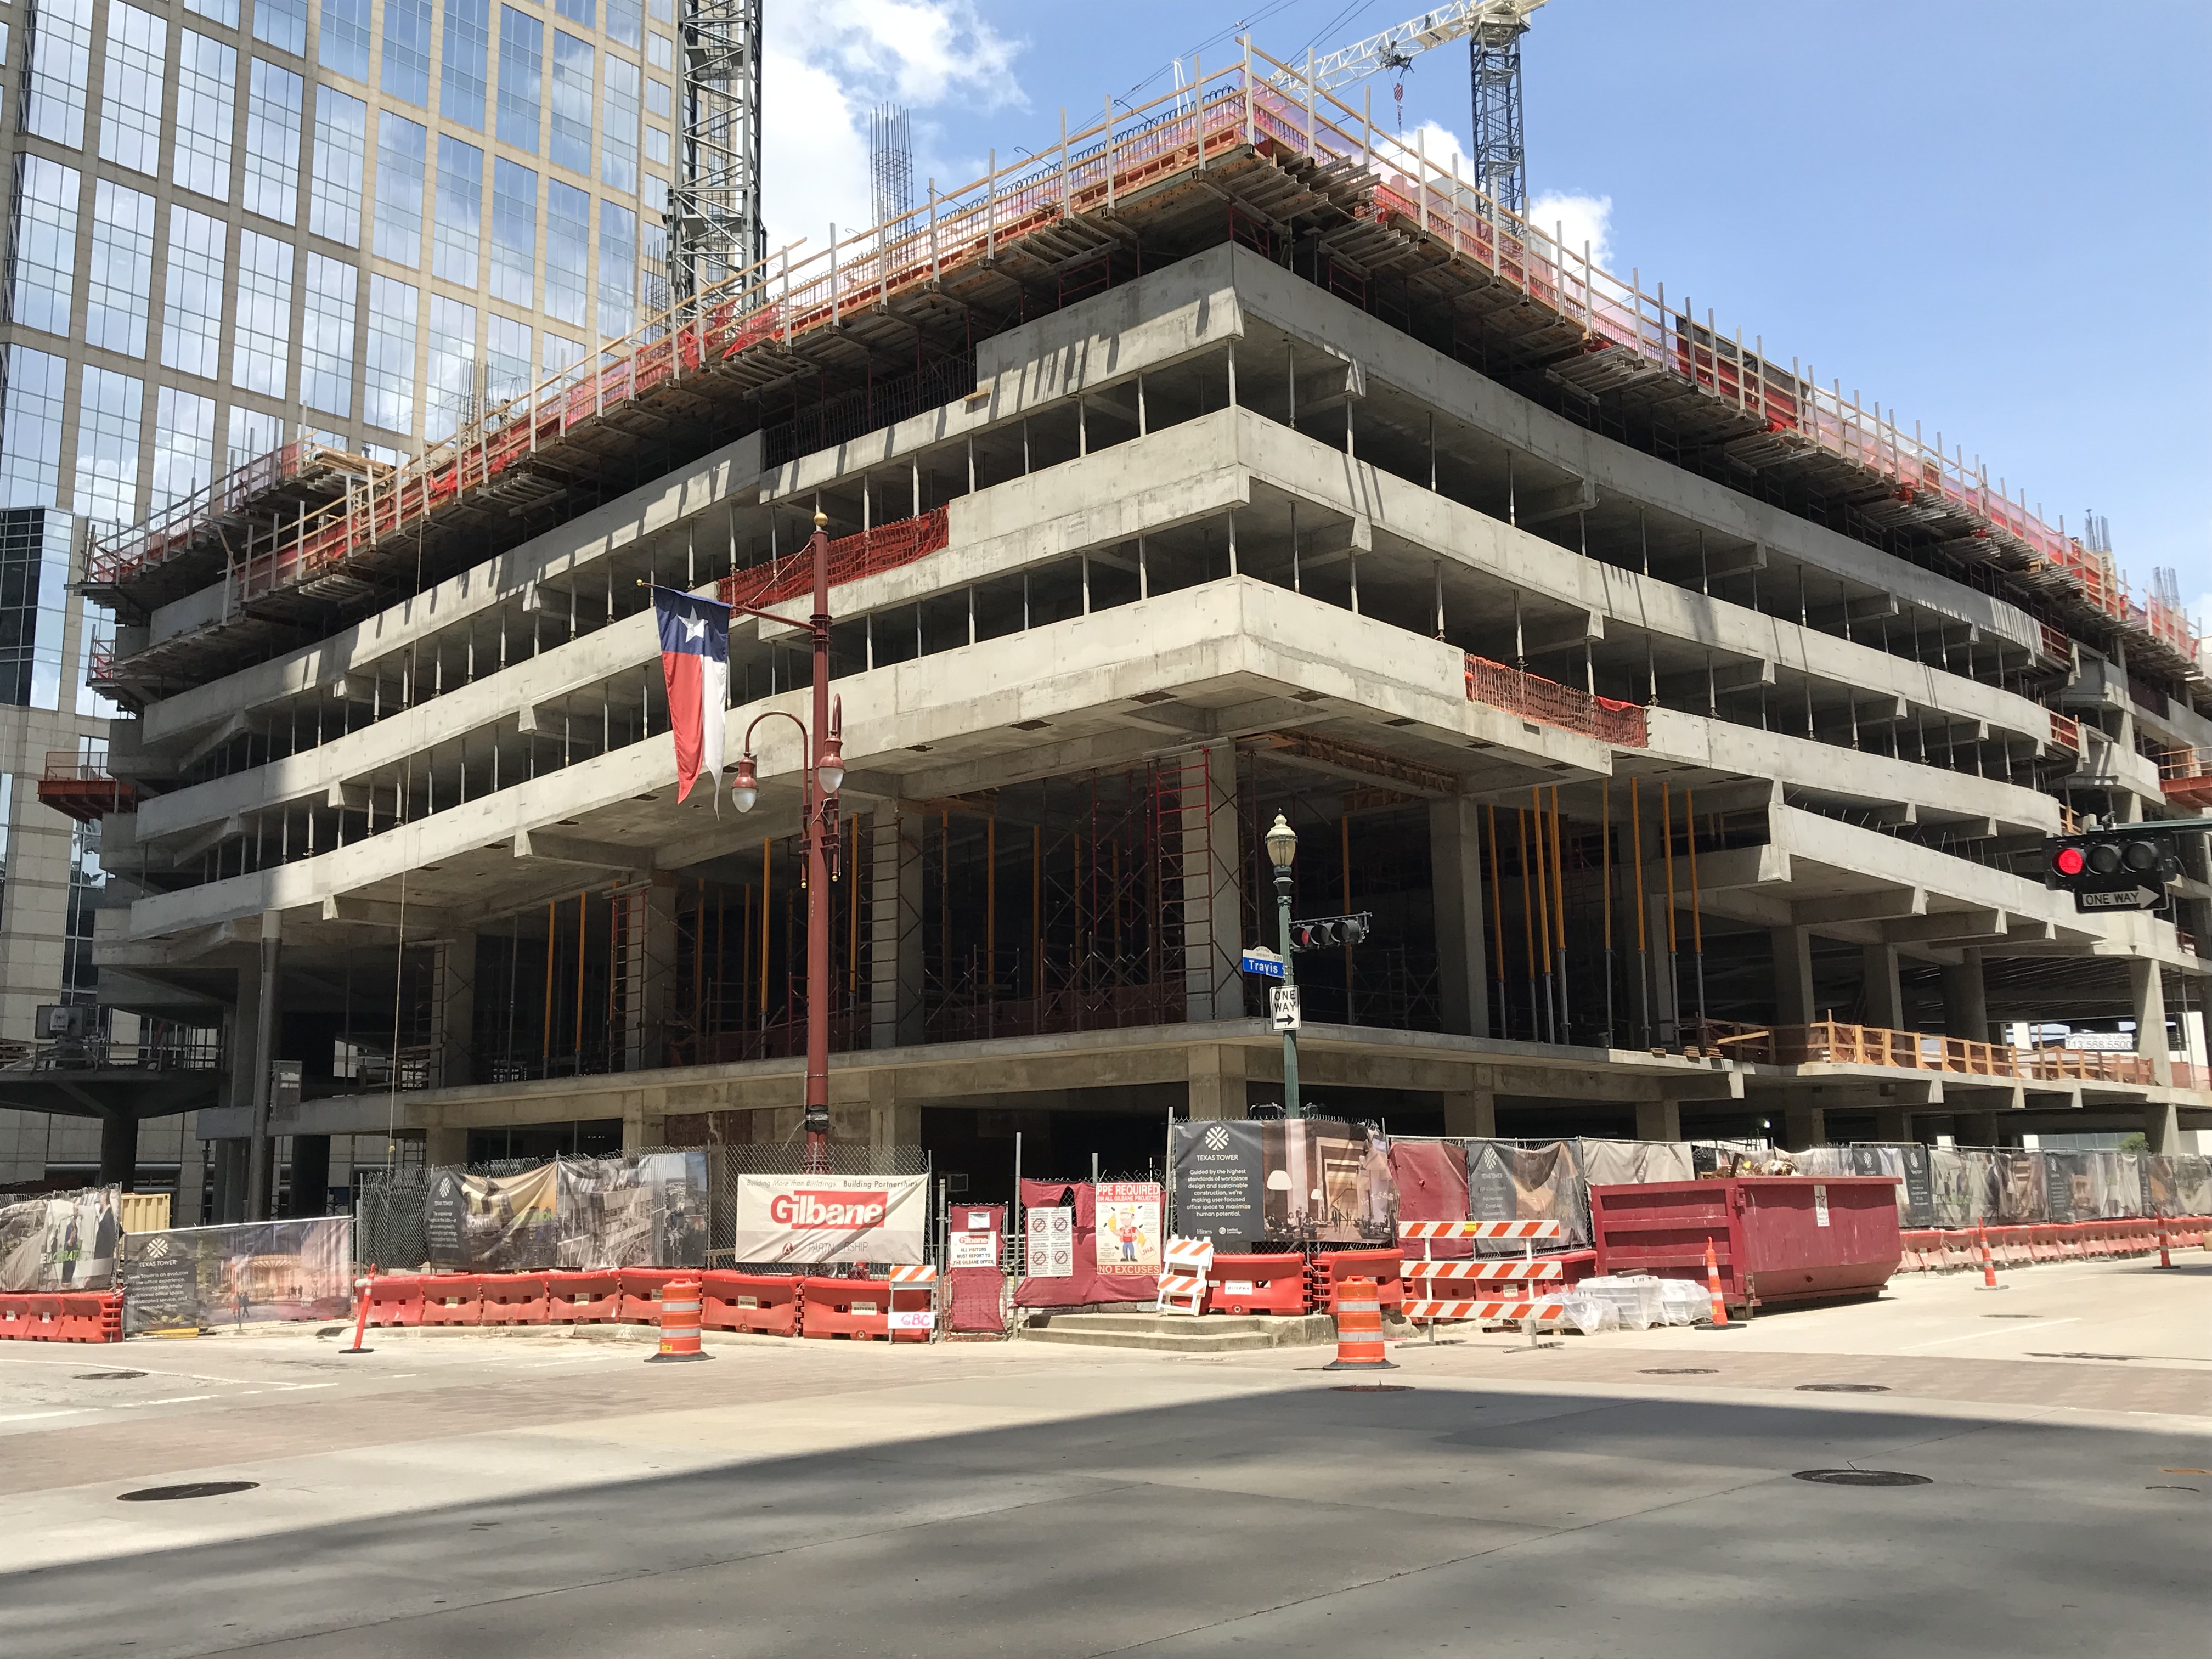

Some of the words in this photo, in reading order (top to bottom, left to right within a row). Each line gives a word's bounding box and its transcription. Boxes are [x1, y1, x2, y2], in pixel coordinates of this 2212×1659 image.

[2086, 894, 2109, 905] ONE
[2114, 891, 2139, 903] WAY
[1248, 960, 1278, 974] Travis
[1274, 990, 1295, 1001] ONE
[1274, 1002, 1296, 1013] WAY
[2065, 1040, 2132, 1049] 713.568.5500
[747, 1179, 771, 1188] Building
[843, 1180, 871, 1189] Building
[1097, 1185, 1113, 1195] PPE
[1115, 1184, 1159, 1195] REQUIRED
[770, 1195, 883, 1225] Gilbane
[959, 1236, 988, 1244] Gilbane
[808, 1241, 868, 1253] PARTNRSHIP
[1142, 1246, 1154, 1256] JHA
[1098, 1266, 1112, 1274] NO
[1115, 1265, 1160, 1273] EXCUSES
